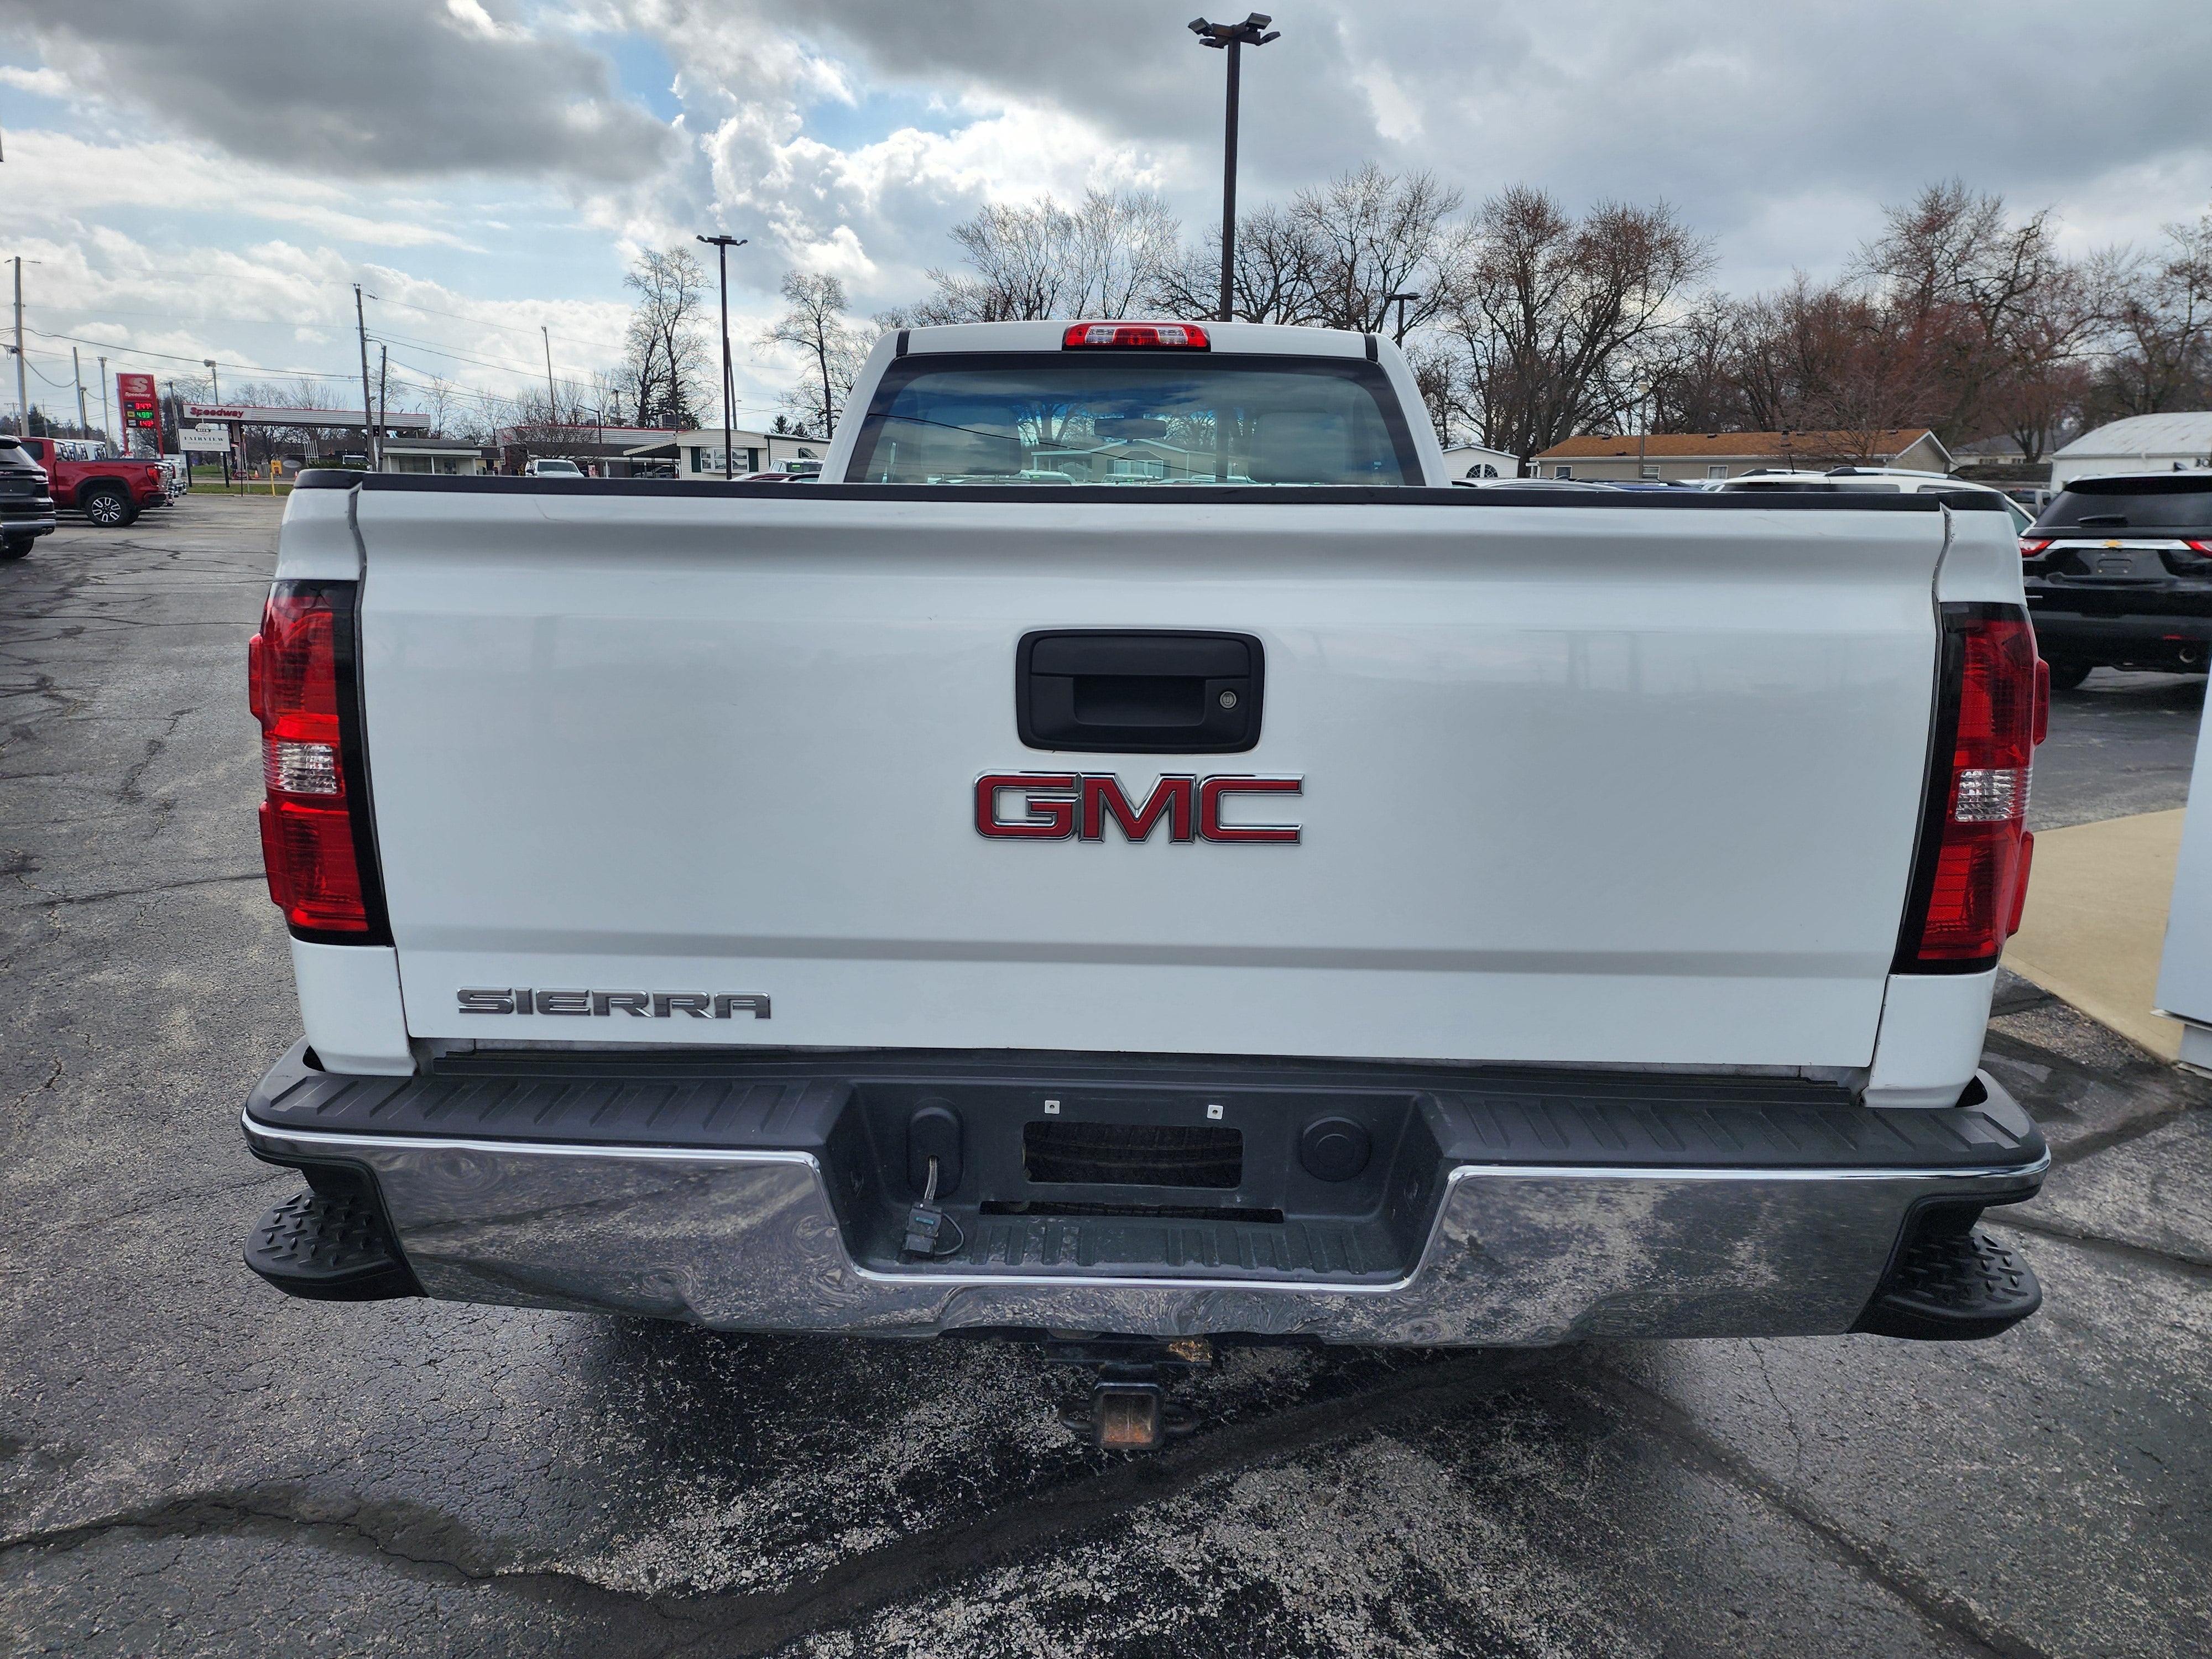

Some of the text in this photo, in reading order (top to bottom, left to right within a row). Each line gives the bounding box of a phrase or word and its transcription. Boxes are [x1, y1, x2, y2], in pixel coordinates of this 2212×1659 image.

[190, 406, 244, 419] Speedway
[973, 769, 1305, 845] GMC
[456, 985, 772, 1019] SIERRA
